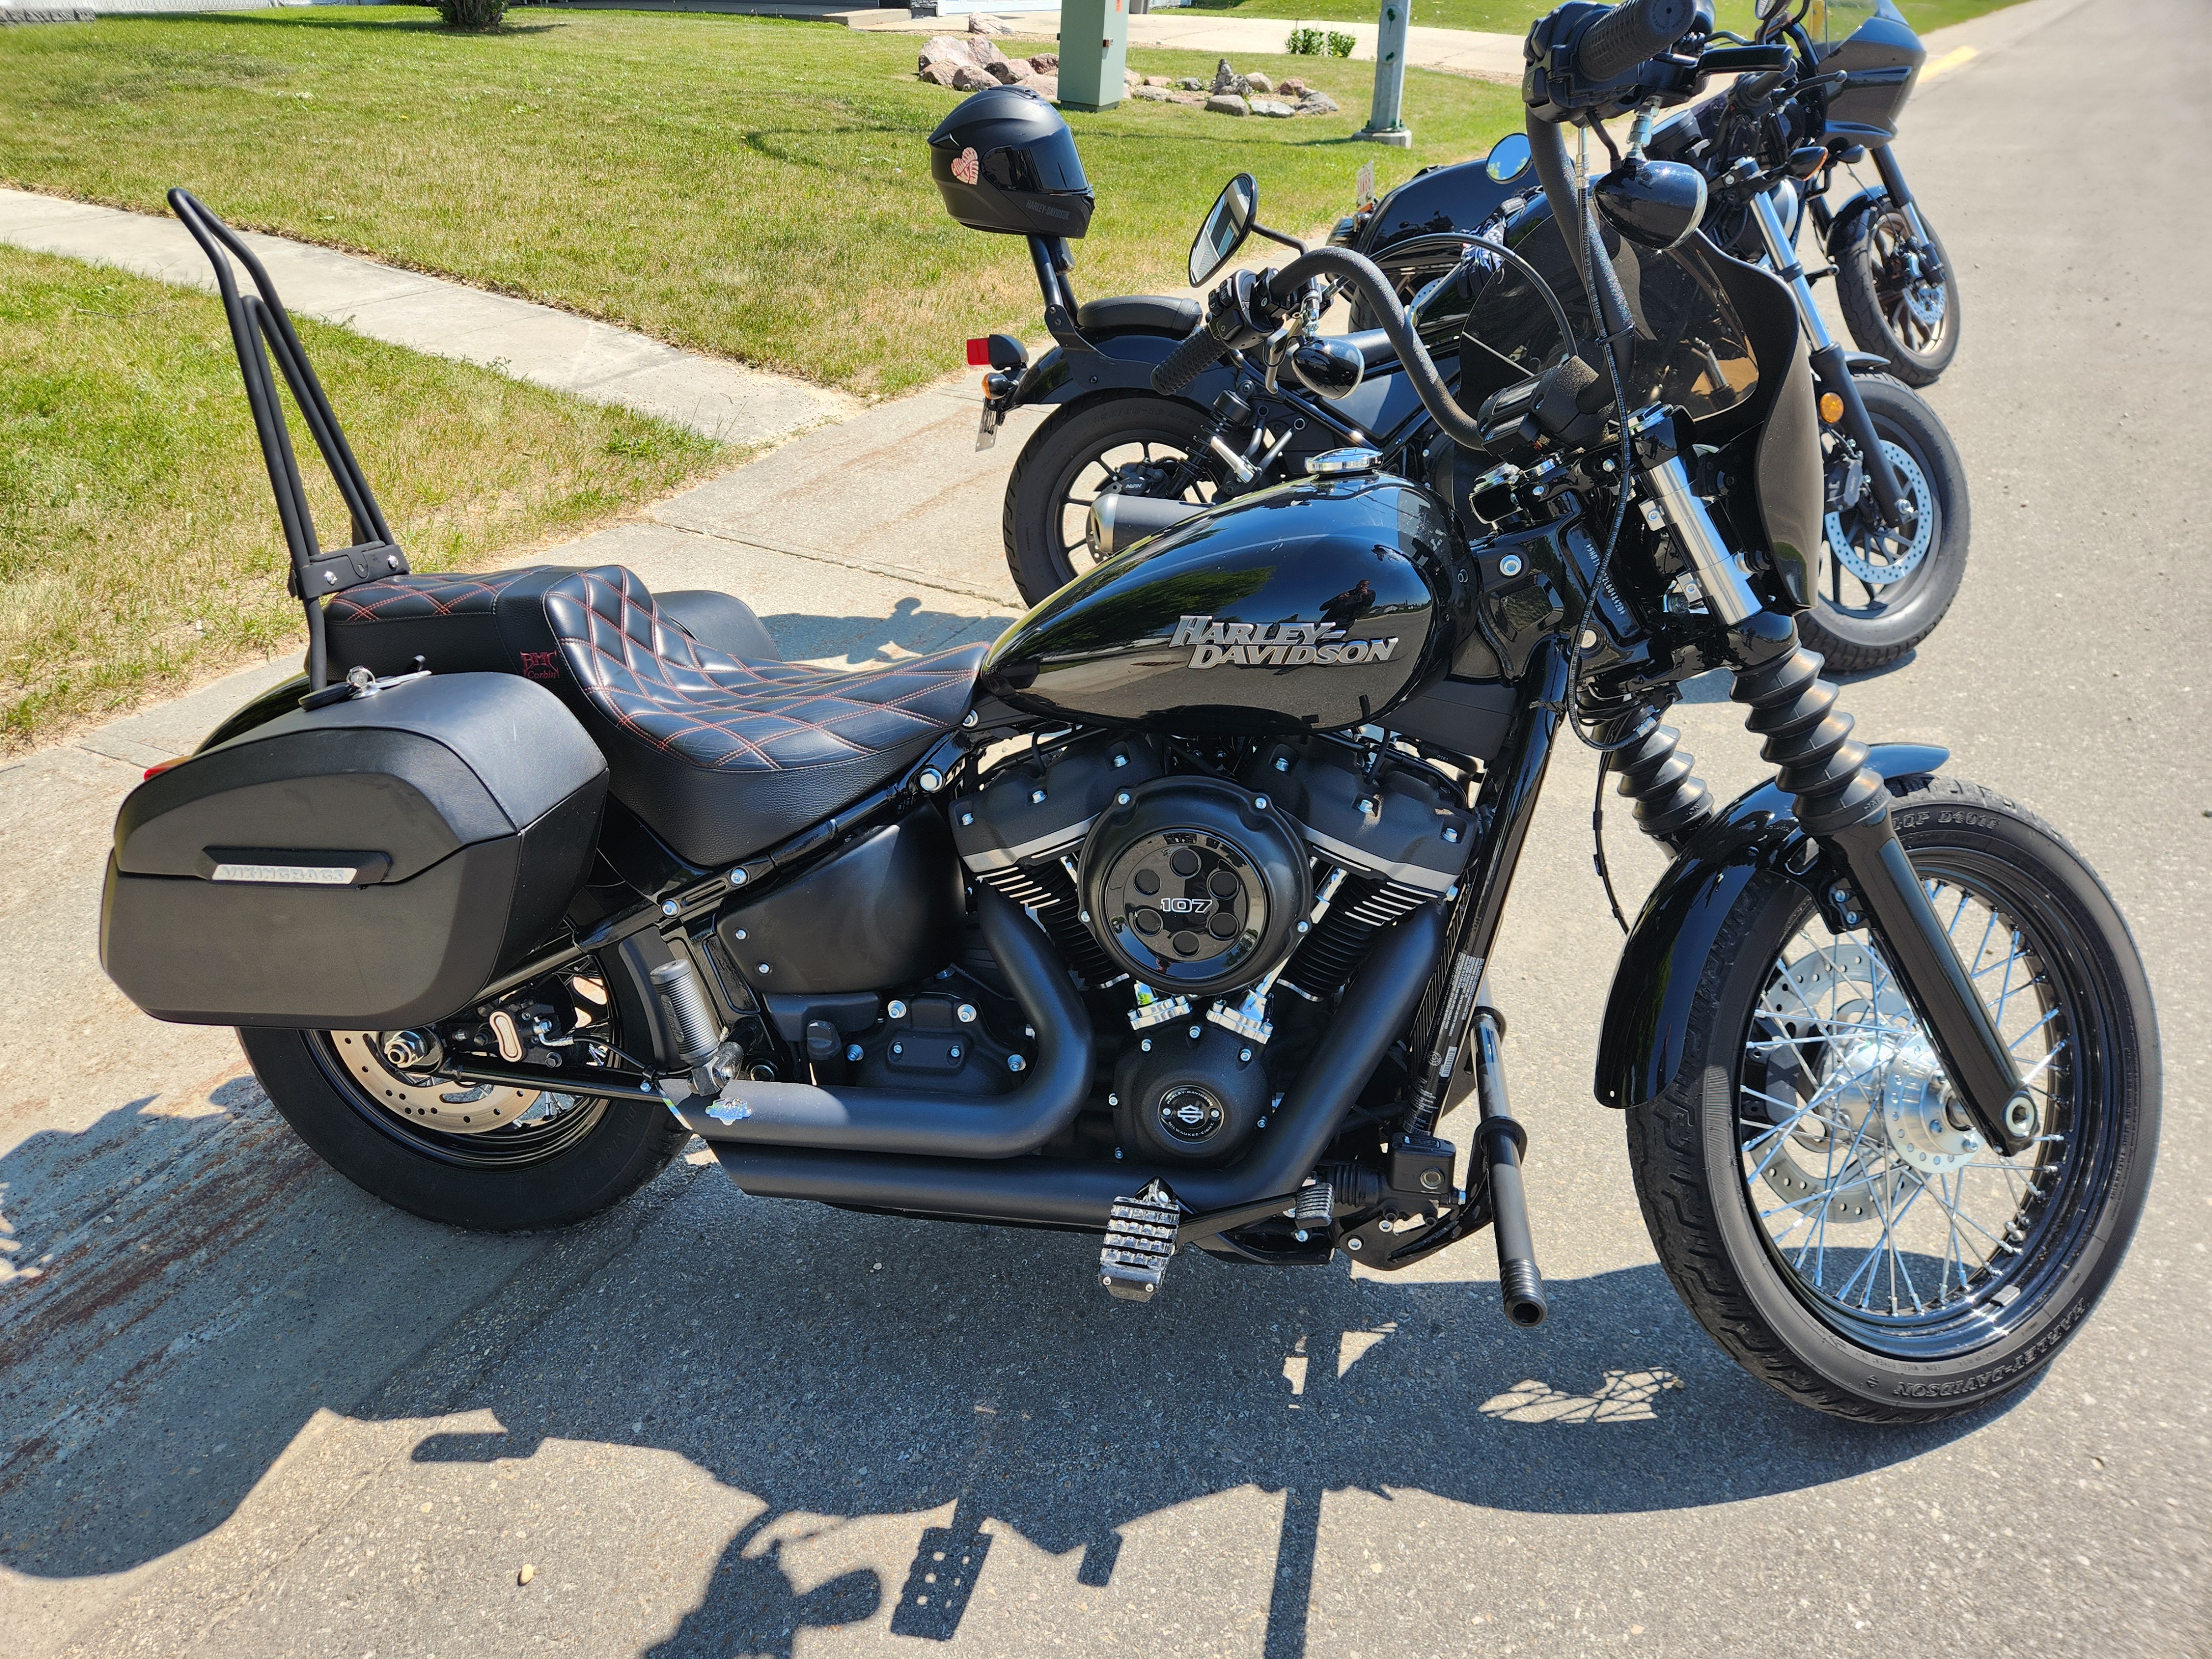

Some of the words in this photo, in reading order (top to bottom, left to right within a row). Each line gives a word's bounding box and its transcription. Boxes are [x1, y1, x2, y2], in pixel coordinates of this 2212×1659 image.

[1026, 200, 1070, 220] HARLEY-DAVIDSON
[1600, 548, 1612, 574] 09/2019
[1188, 637, 1399, 669] DAVIDSON
[528, 670, 556, 679] Corbin
[1161, 898, 1213, 913] 107
[1893, 1296, 2090, 1399] HARLEY-DAVIDSON
